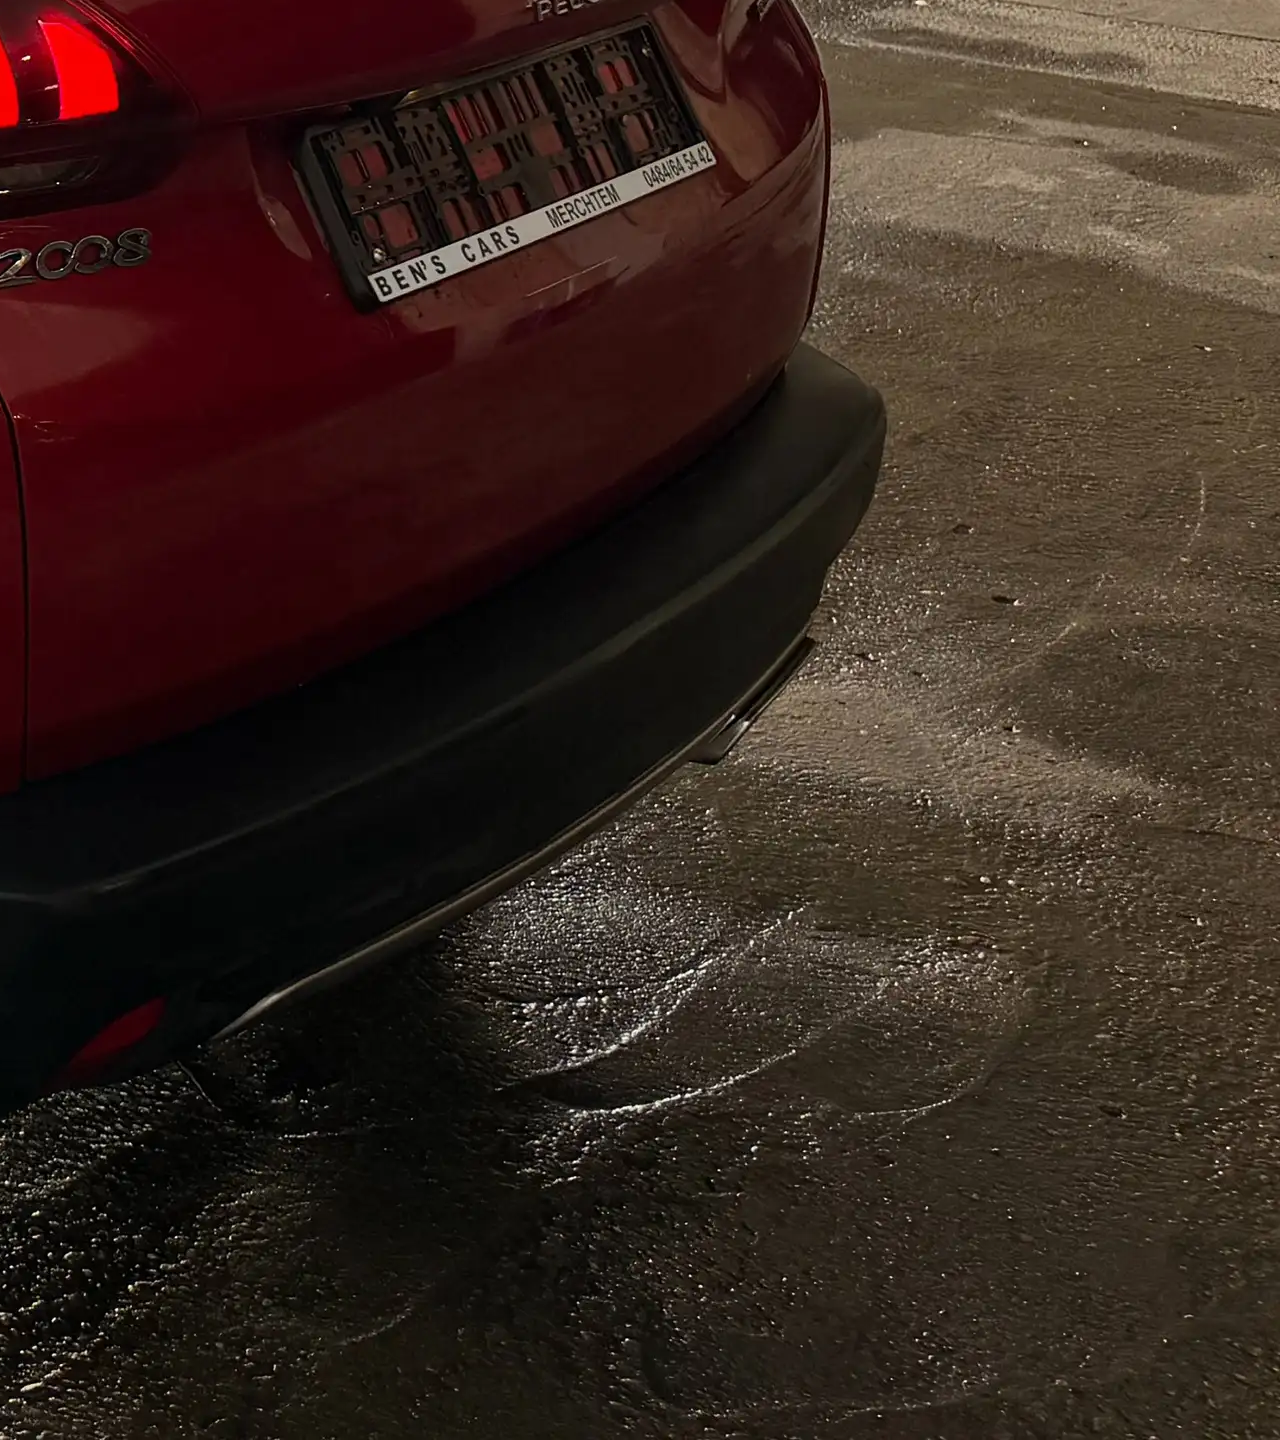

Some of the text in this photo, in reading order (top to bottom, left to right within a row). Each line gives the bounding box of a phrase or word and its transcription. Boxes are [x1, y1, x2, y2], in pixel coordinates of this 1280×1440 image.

[375, 145, 712, 297] BEN'S CARS MERCHTEM 0484/64 54 42
